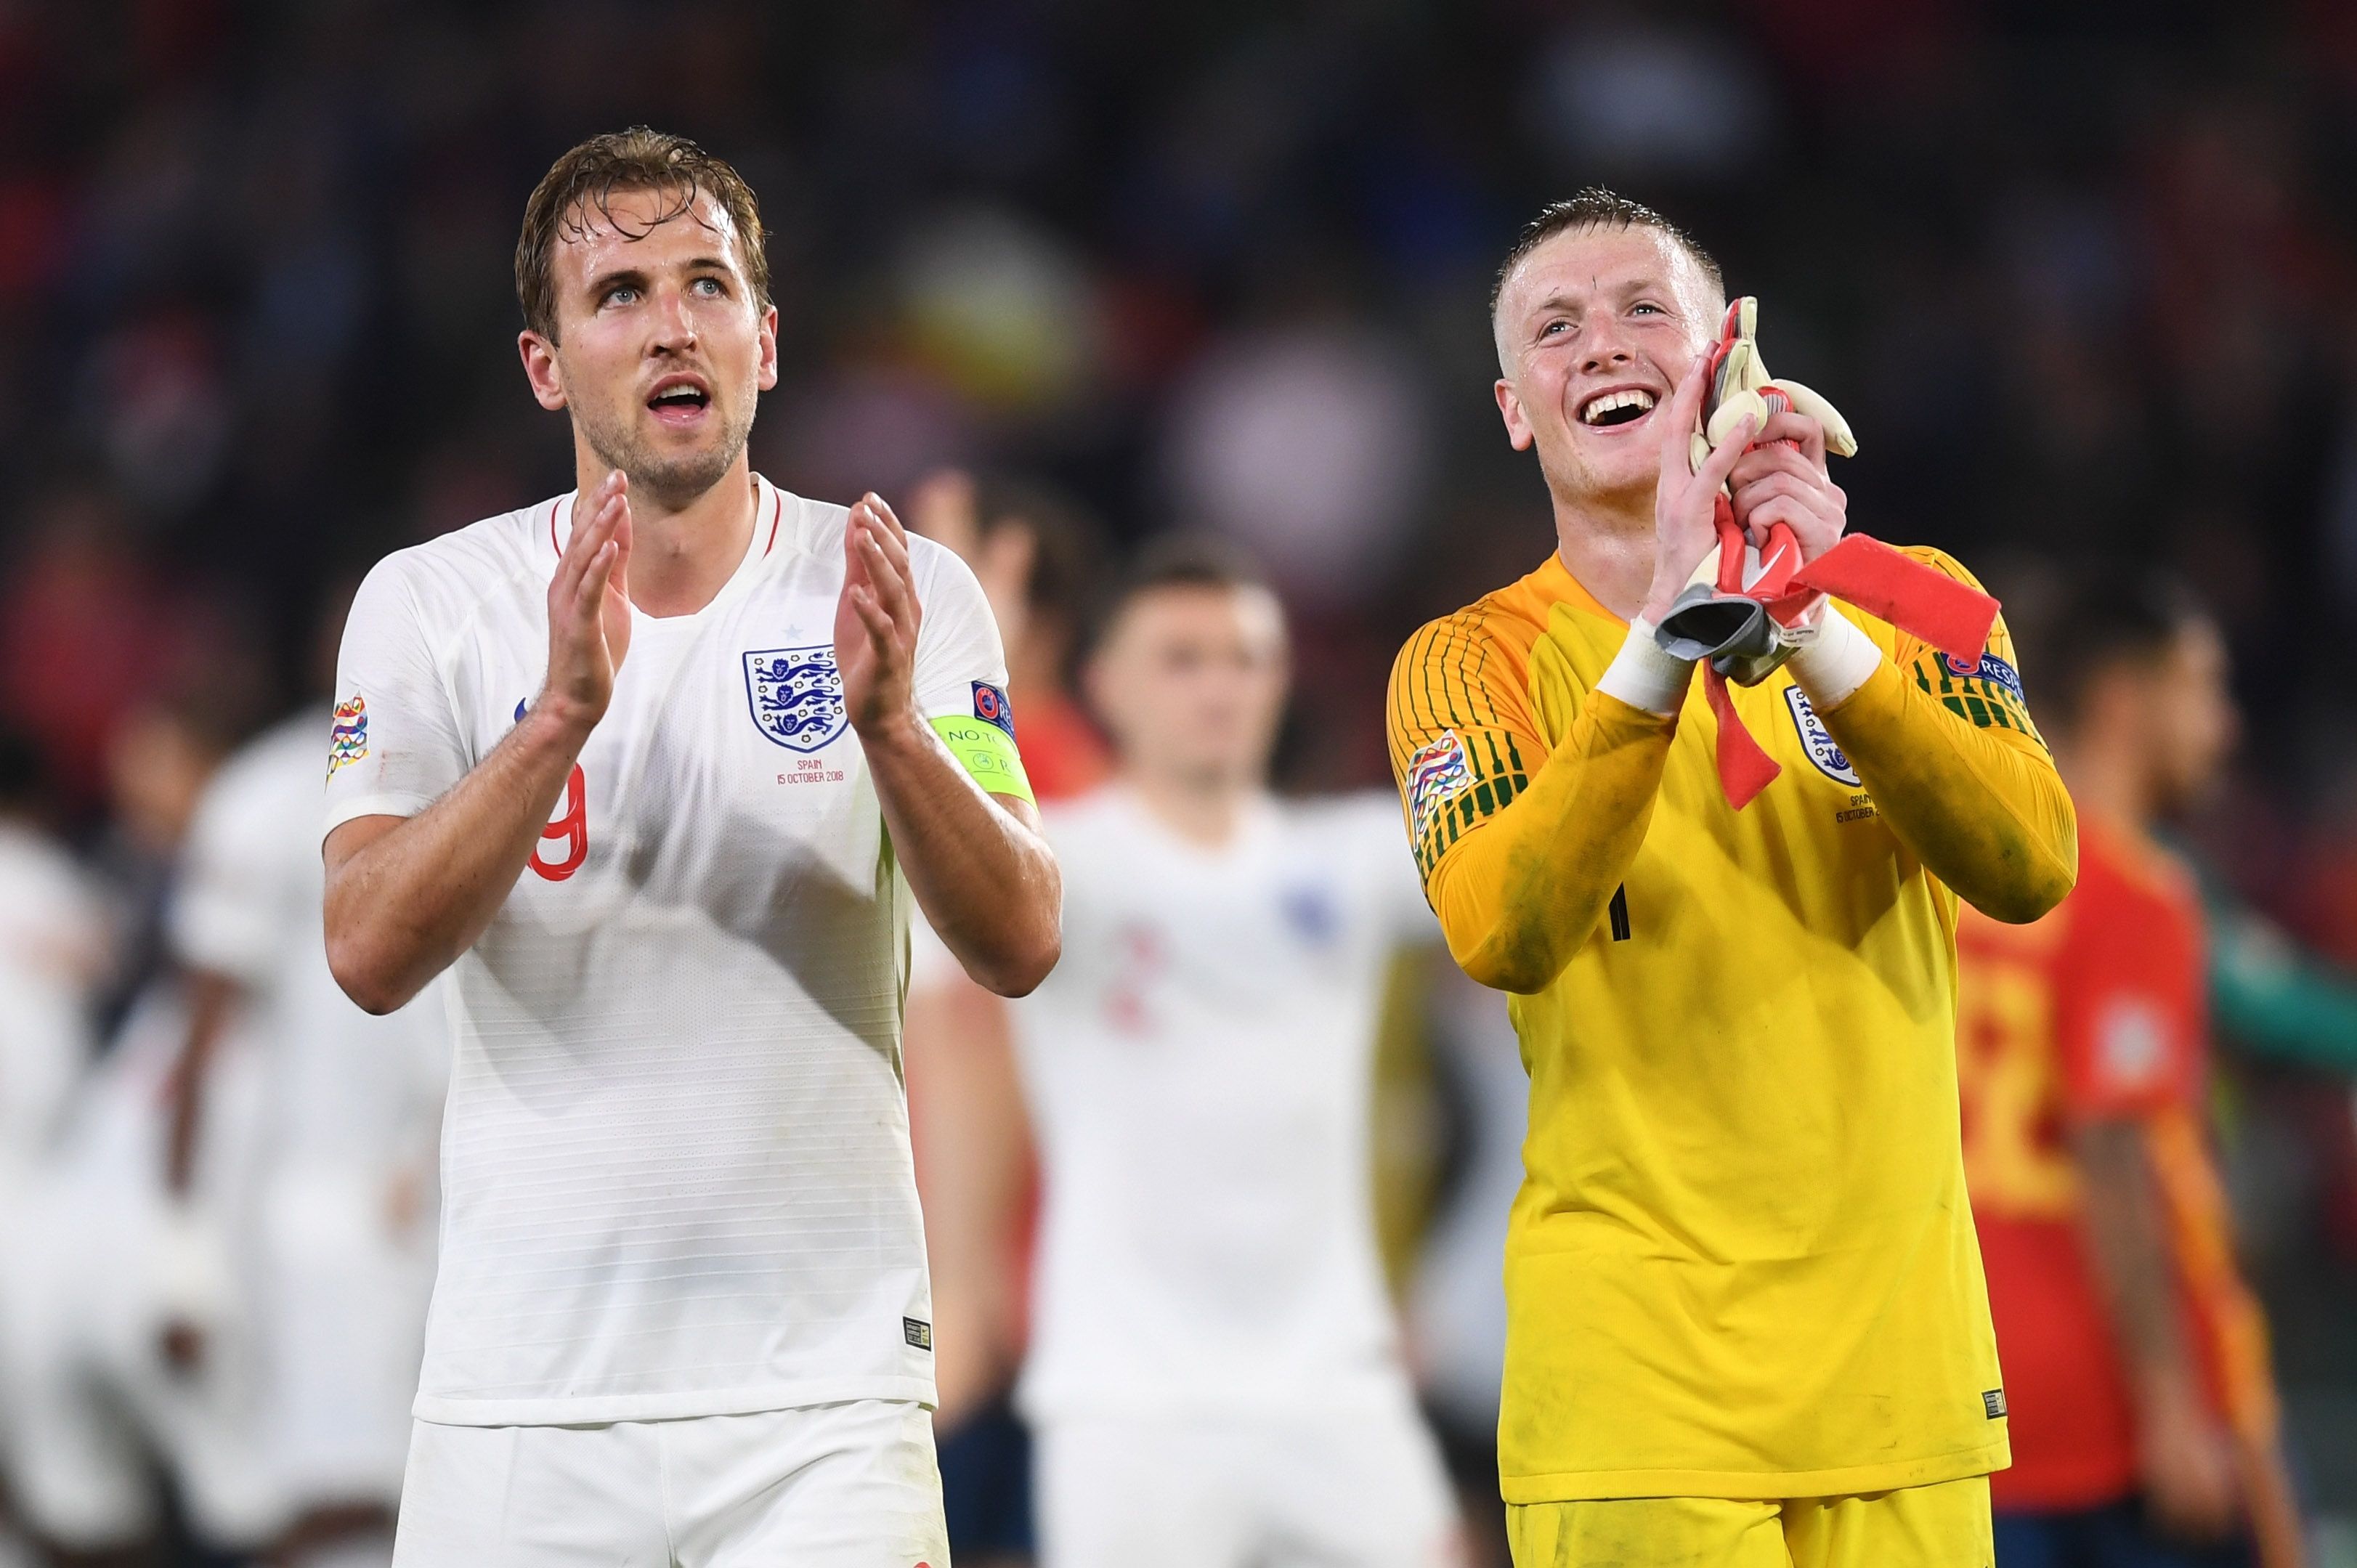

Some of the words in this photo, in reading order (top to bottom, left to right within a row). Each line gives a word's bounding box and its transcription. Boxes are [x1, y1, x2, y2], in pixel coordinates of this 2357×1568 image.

[949, 730, 980, 742] NO
[797, 759, 822, 771] SPAIN
[777, 773, 786, 784] 15
[787, 771, 825, 784] OCTOBER
[826, 771, 844, 782] 2018
[1844, 806, 1875, 822] OCTOBER
[527, 761, 588, 882] 9
